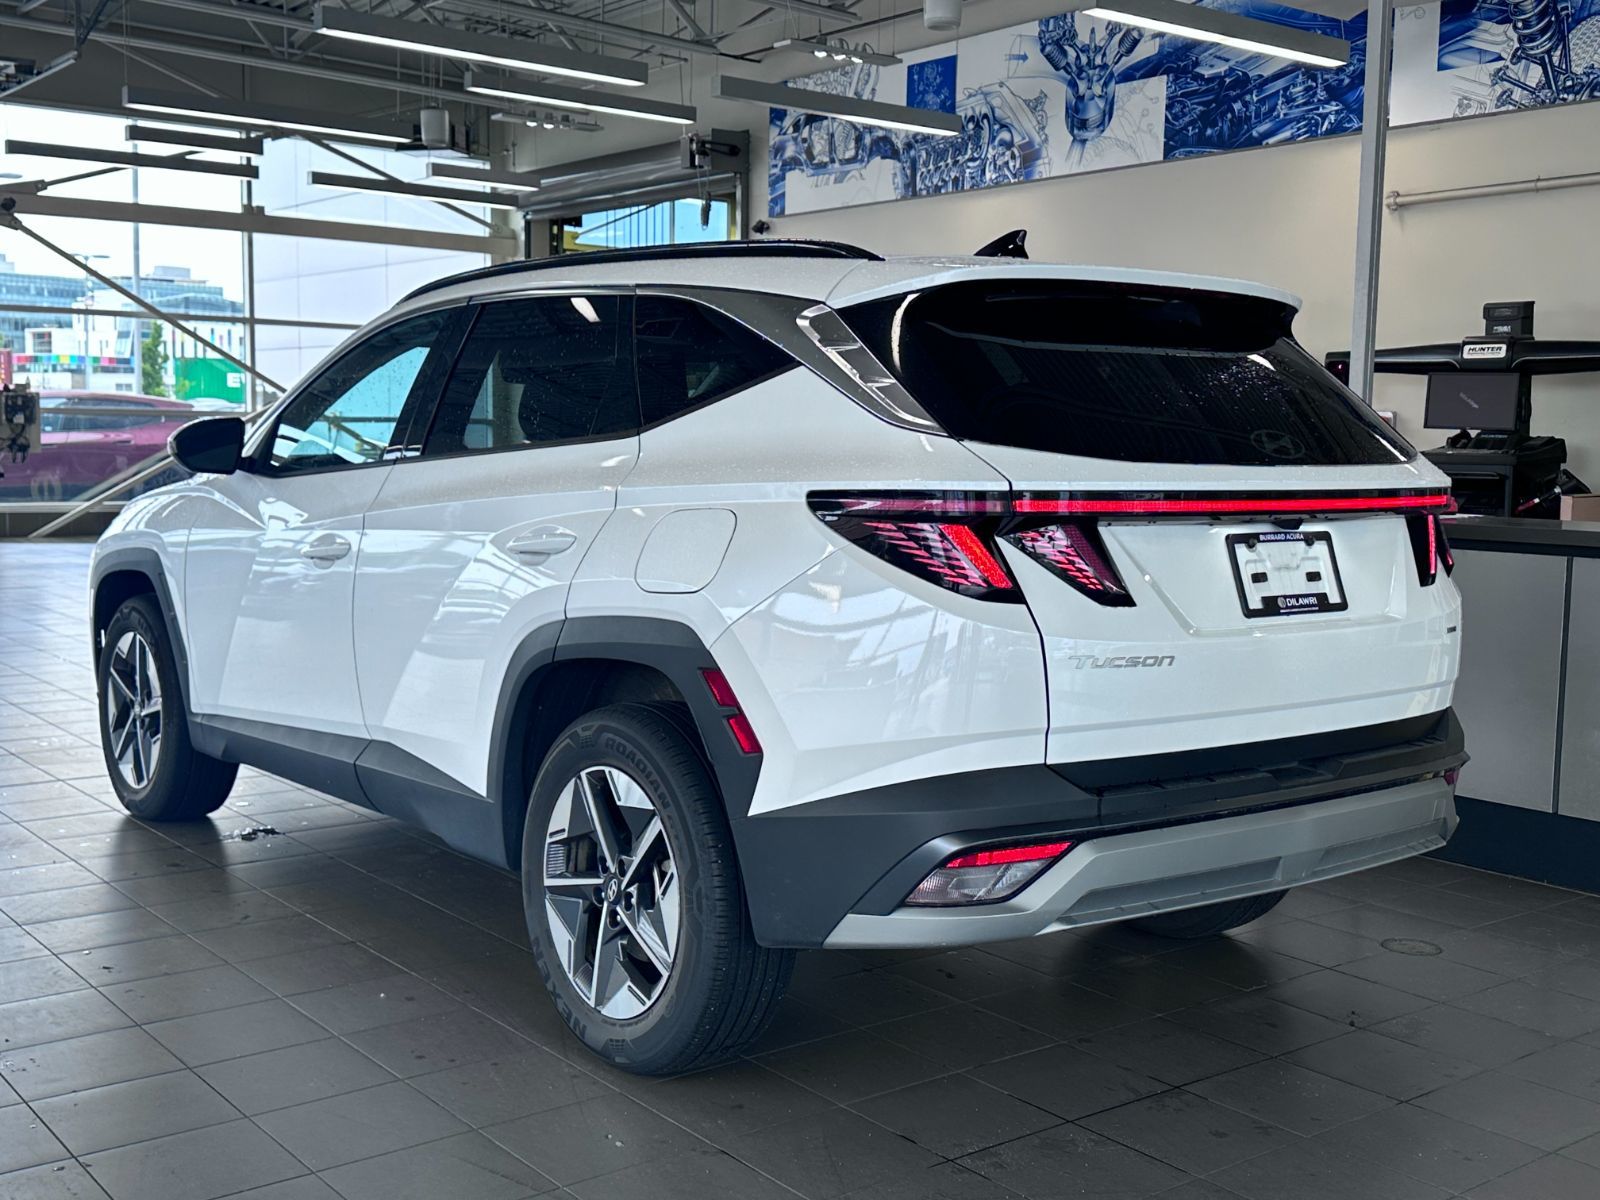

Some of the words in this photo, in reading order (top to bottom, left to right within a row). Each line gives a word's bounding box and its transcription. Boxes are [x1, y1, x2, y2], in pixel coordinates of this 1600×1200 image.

[1259, 533, 1285, 541] BURRARD
[1286, 597, 1318, 606] DILAWRI
[604, 735, 672, 810] ROADIAN
[531, 936, 588, 1040] NEXEN
